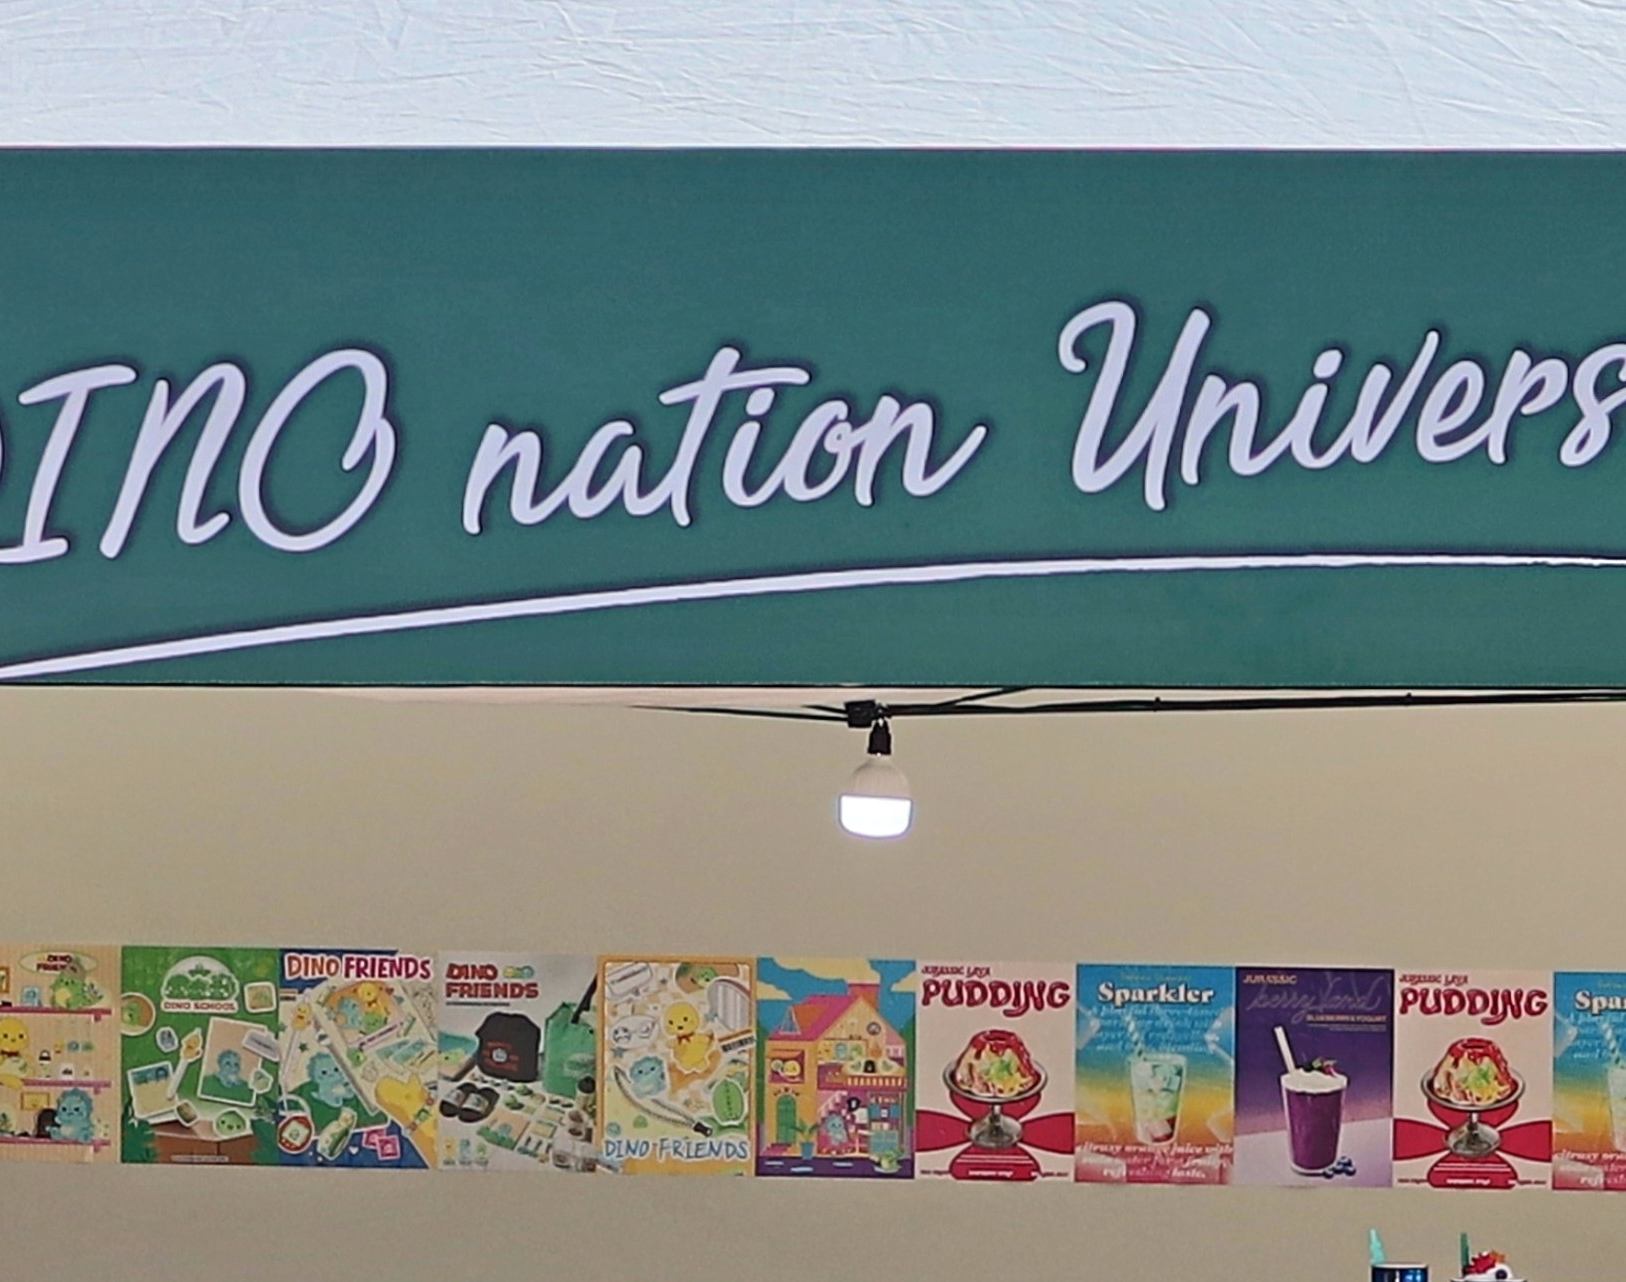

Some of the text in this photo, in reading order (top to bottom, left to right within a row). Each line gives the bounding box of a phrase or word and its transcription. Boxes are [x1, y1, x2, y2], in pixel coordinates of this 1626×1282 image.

[462, 346, 987, 535] nation
[287, 955, 433, 980] DINO FRIENDS
[445, 963, 499, 981] DINO
[445, 982, 540, 999] FRIENDS
[921, 979, 1072, 1018] PUDDING
[1097, 980, 1215, 1009] Sparkler
[1399, 987, 1549, 1026] PUDDING
[604, 1137, 749, 1161] DINO FRIENDS
